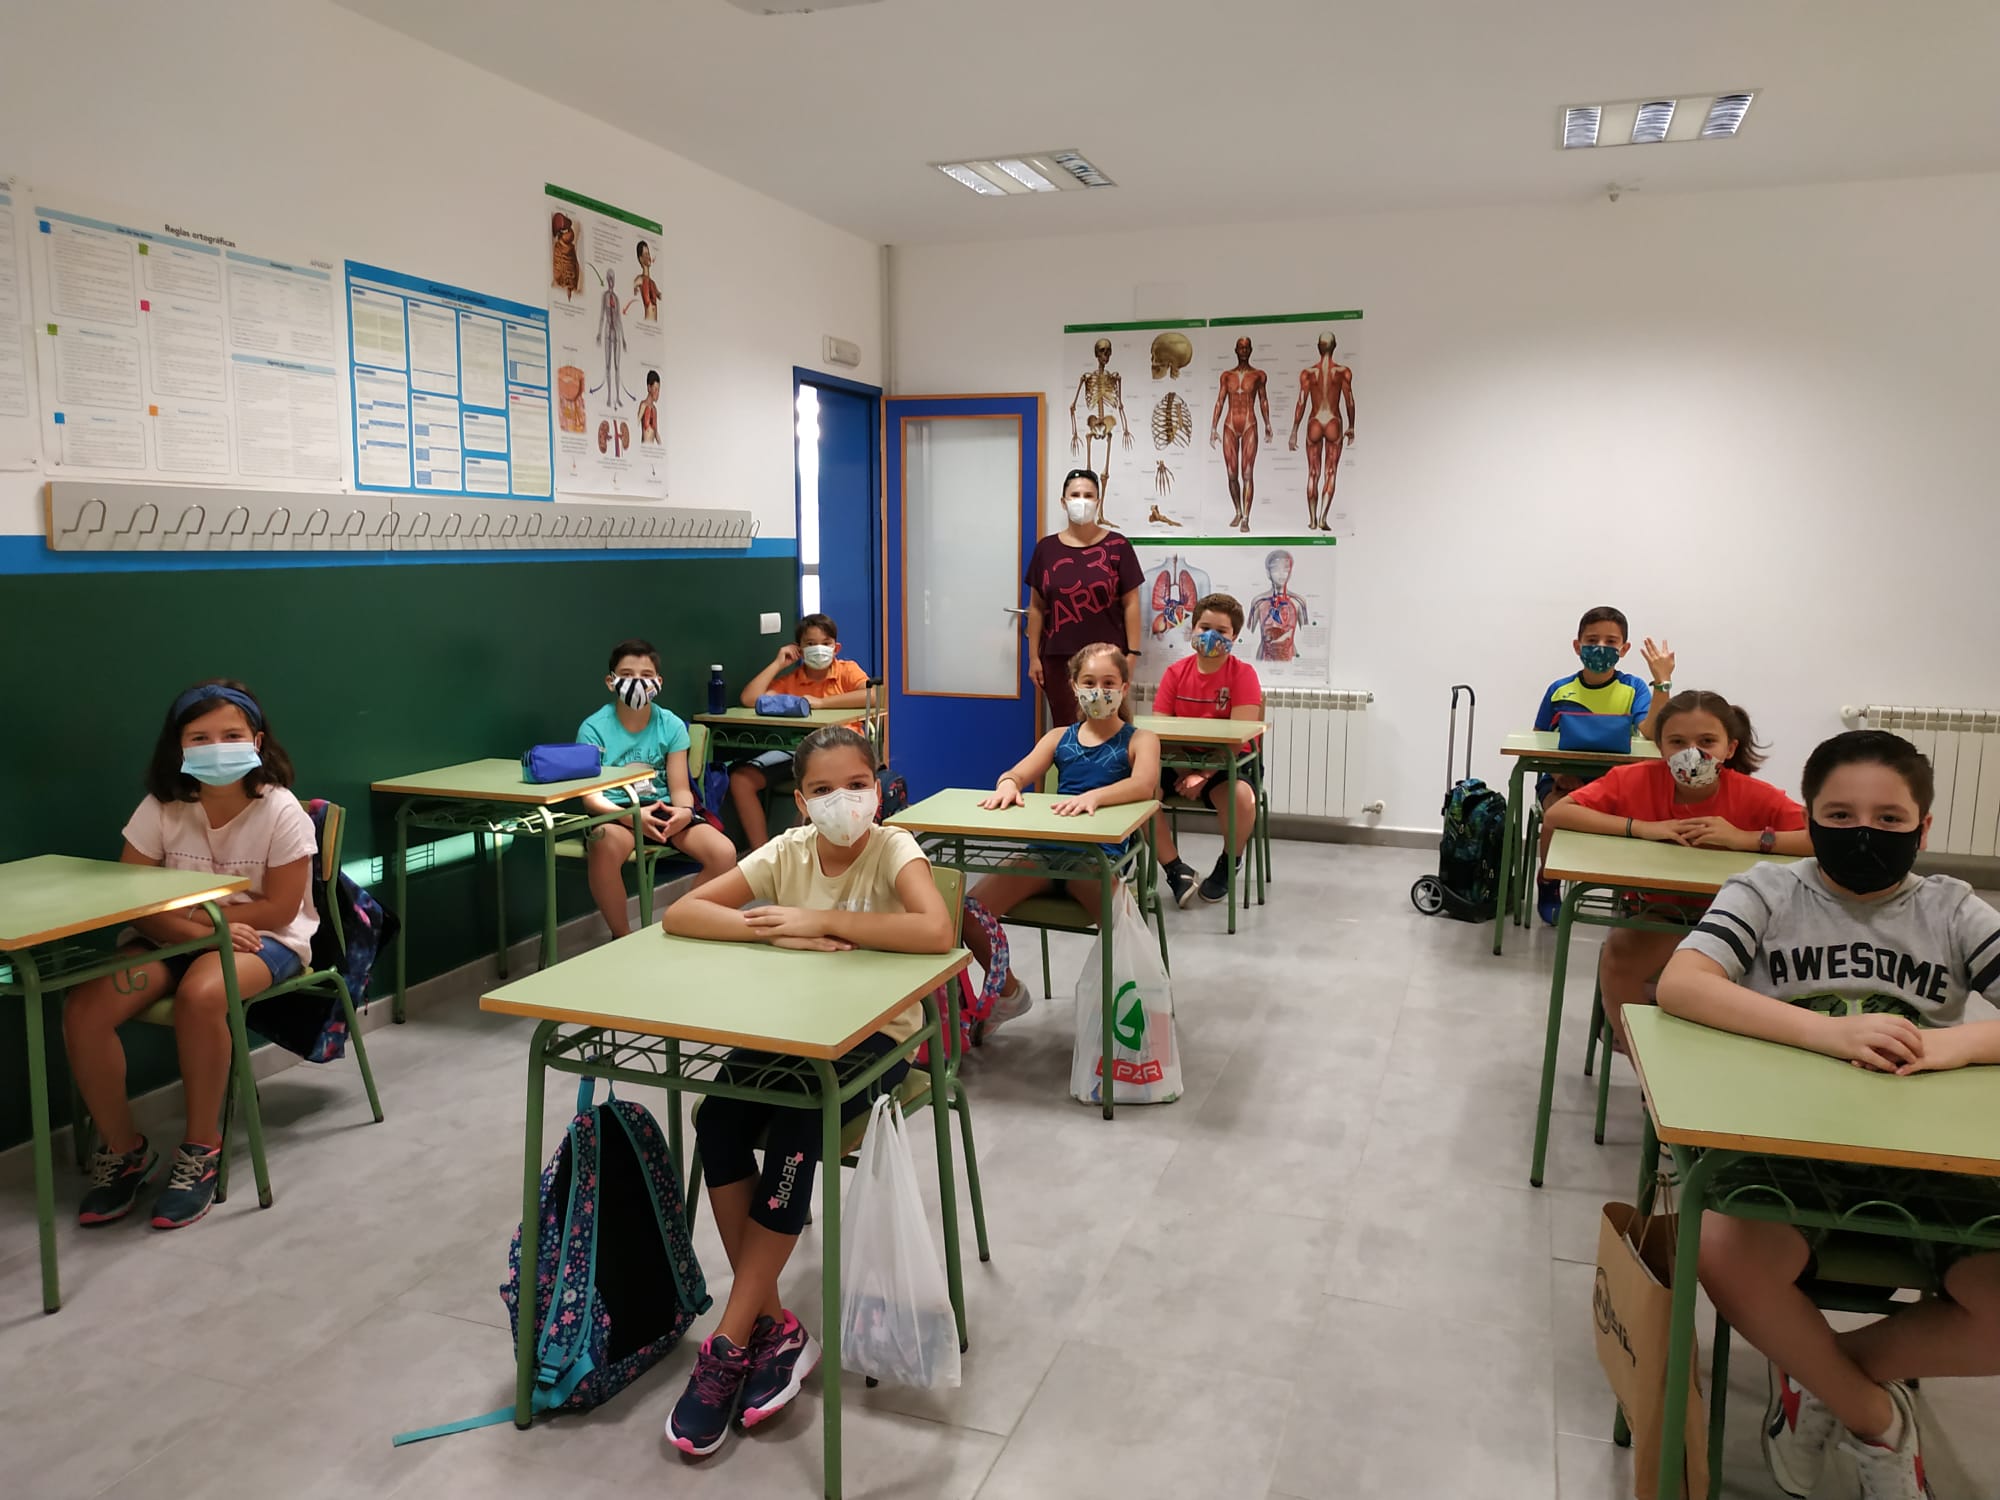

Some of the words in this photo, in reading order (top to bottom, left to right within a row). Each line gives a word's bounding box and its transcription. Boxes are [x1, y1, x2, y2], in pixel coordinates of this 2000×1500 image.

[164, 223, 191, 238] Reglas
[1769, 942, 1949, 1004] AWESOME
[1100, 1063, 1161, 1082] PAR
[776, 1155, 799, 1209] BEFORE
